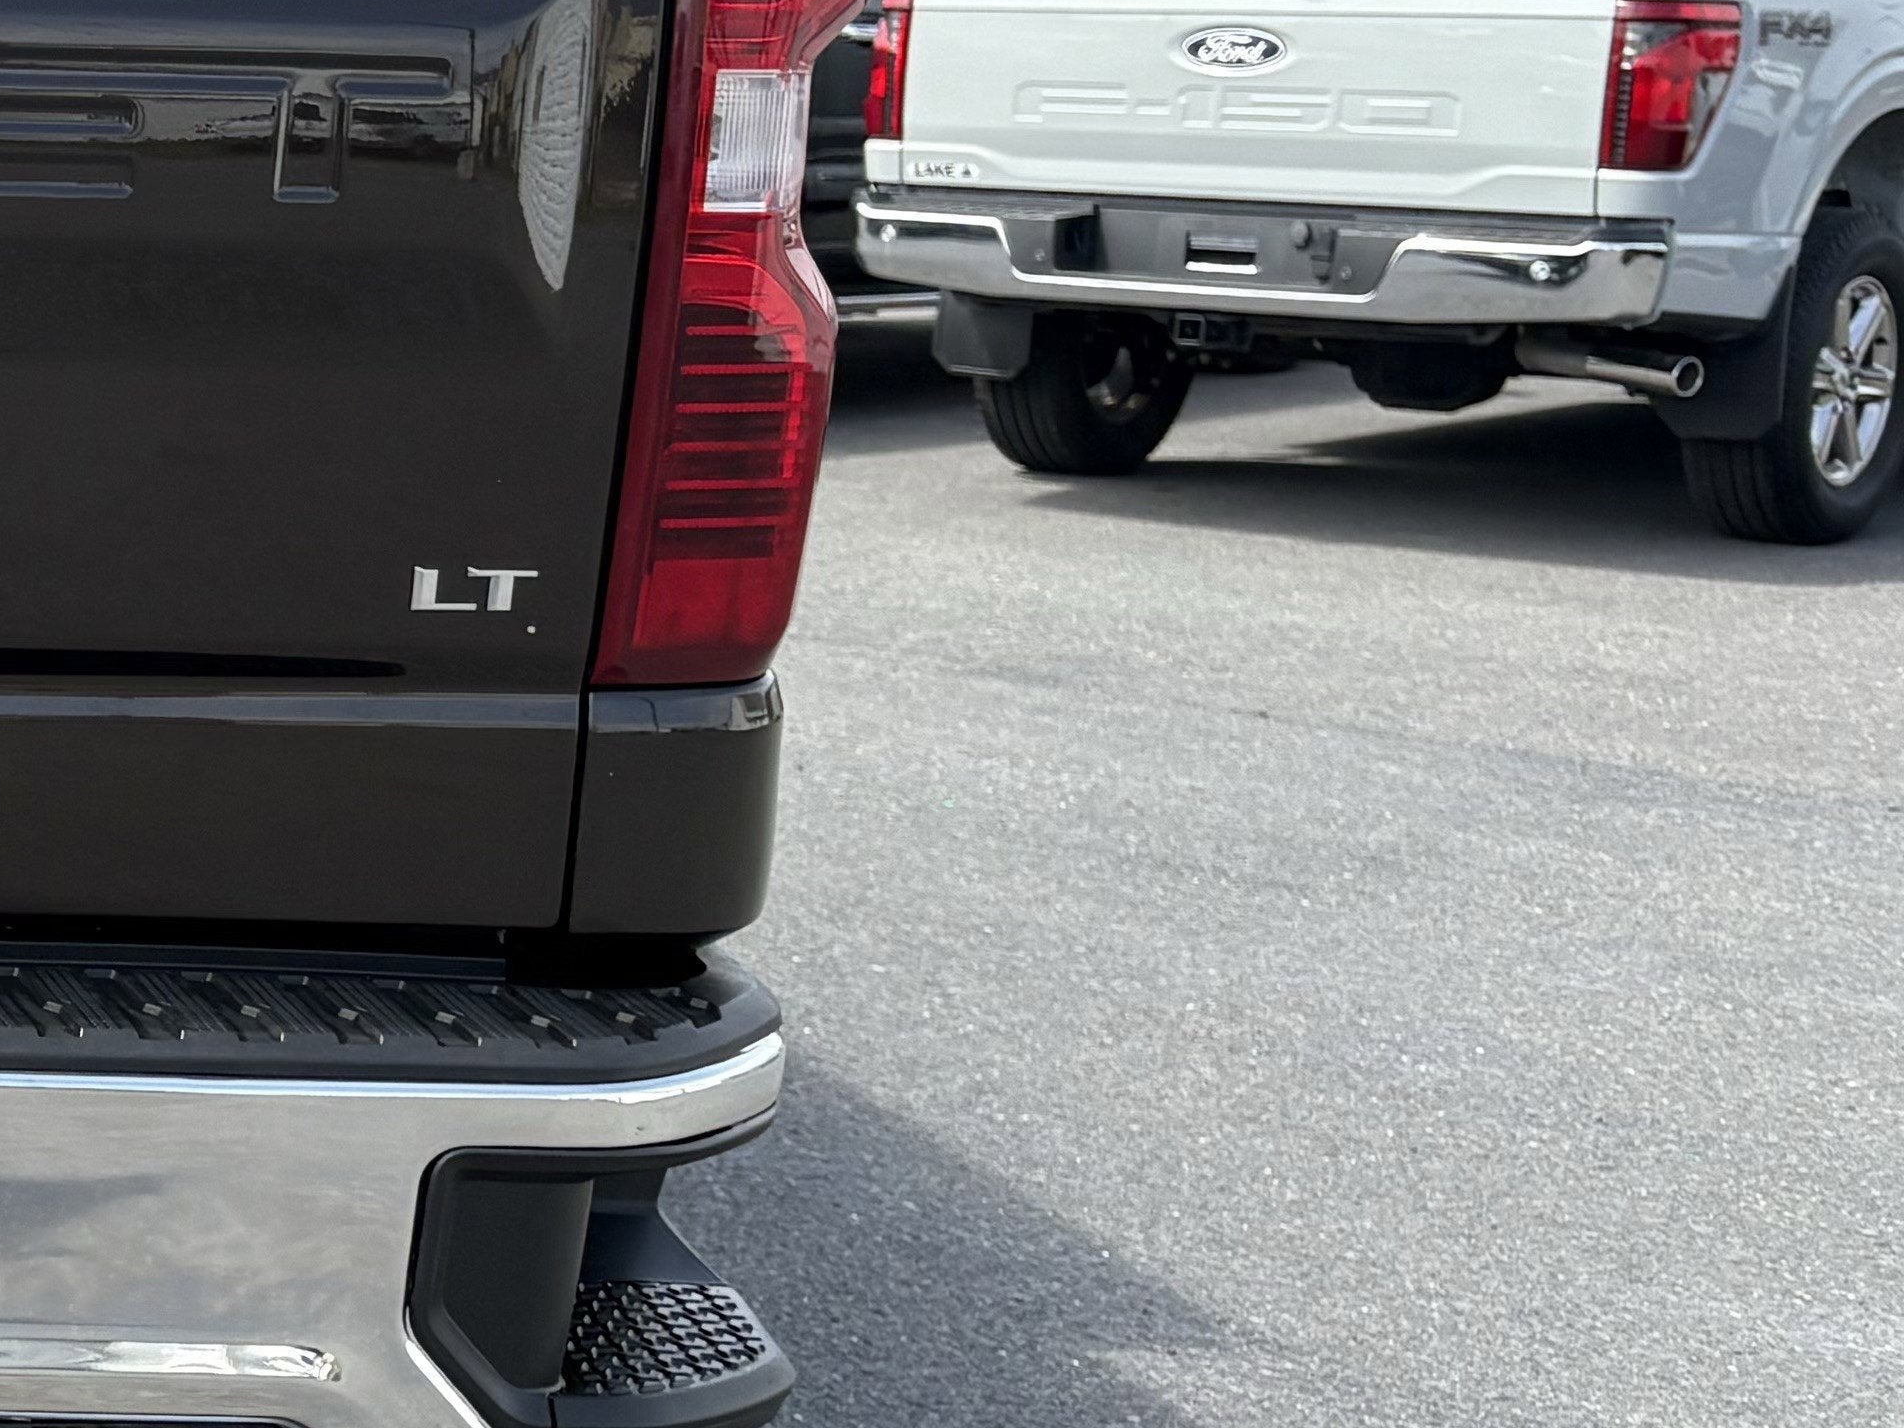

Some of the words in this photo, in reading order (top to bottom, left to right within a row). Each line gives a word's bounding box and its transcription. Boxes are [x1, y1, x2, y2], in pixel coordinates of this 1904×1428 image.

[1758, 10, 1832, 42] FX4
[1197, 34, 1267, 63] Ford
[1011, 79, 1463, 137] F-150
[914, 162, 956, 178] LAKE
[409, 565, 540, 612] LT
